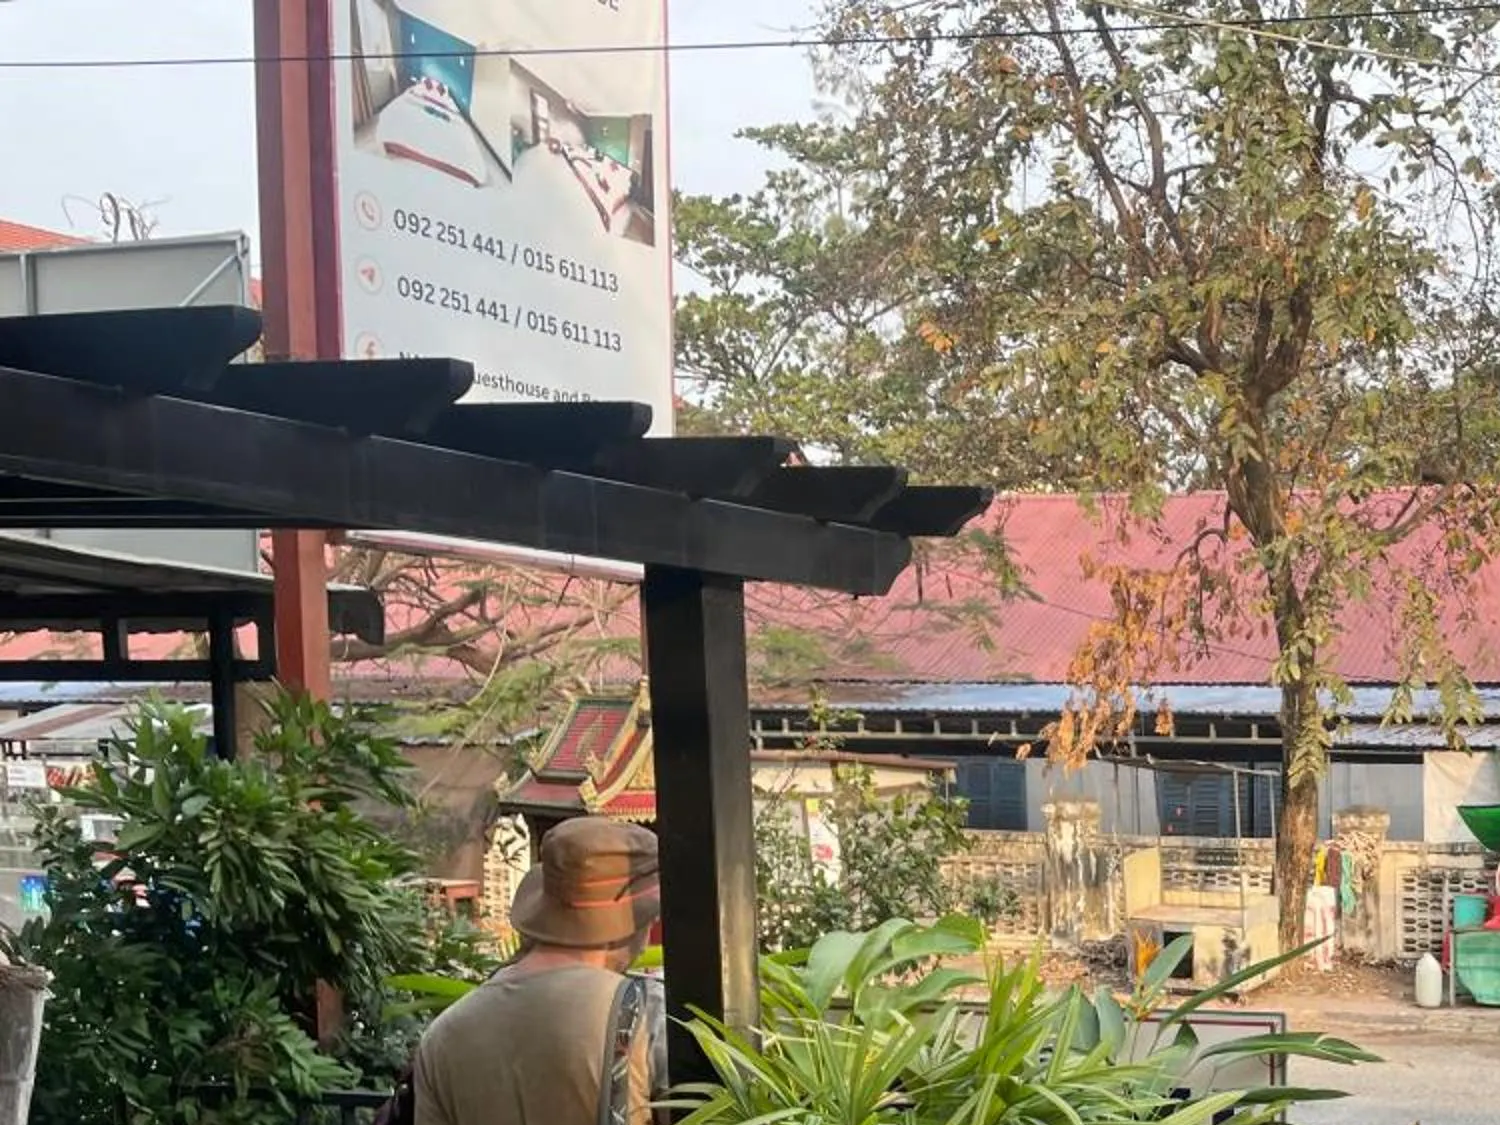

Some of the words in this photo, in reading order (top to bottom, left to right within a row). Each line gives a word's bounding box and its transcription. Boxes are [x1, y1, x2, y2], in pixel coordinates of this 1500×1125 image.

[394, 209, 431, 238] 092
[437, 221, 468, 249] 251
[473, 233, 507, 261] 441
[523, 247, 555, 273] 015
[559, 259, 588, 283] 611
[590, 268, 619, 293] 113
[397, 276, 435, 304] 092
[440, 287, 472, 314] 251
[476, 298, 510, 324] 441
[527, 310, 558, 336] 015
[562, 320, 591, 345] 611
[594, 329, 622, 353] 113
[474, 372, 550, 400] uesthouse
